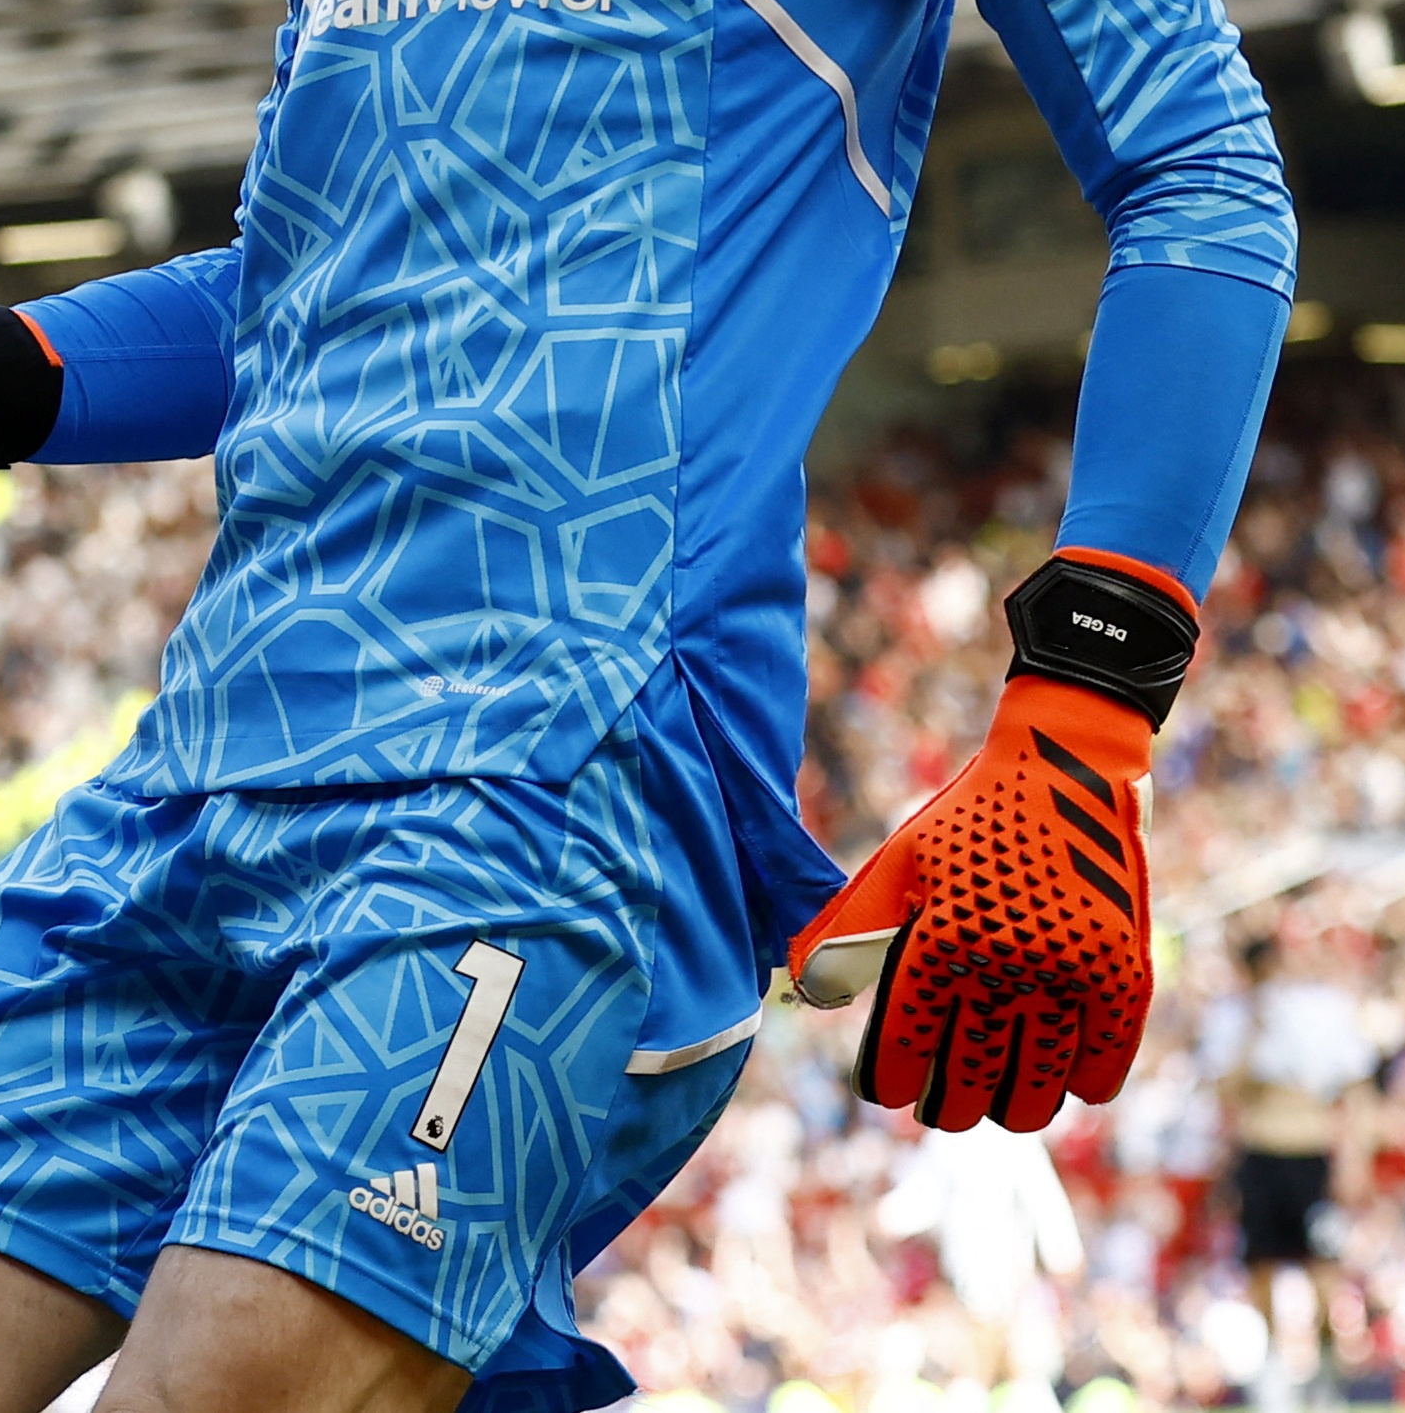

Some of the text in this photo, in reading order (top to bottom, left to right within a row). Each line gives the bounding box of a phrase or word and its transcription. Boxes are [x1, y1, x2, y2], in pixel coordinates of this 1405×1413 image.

[1072, 610, 1128, 642] DE GEA
[410, 938, 527, 1154] 1
[348, 1186, 445, 1251] adidas
